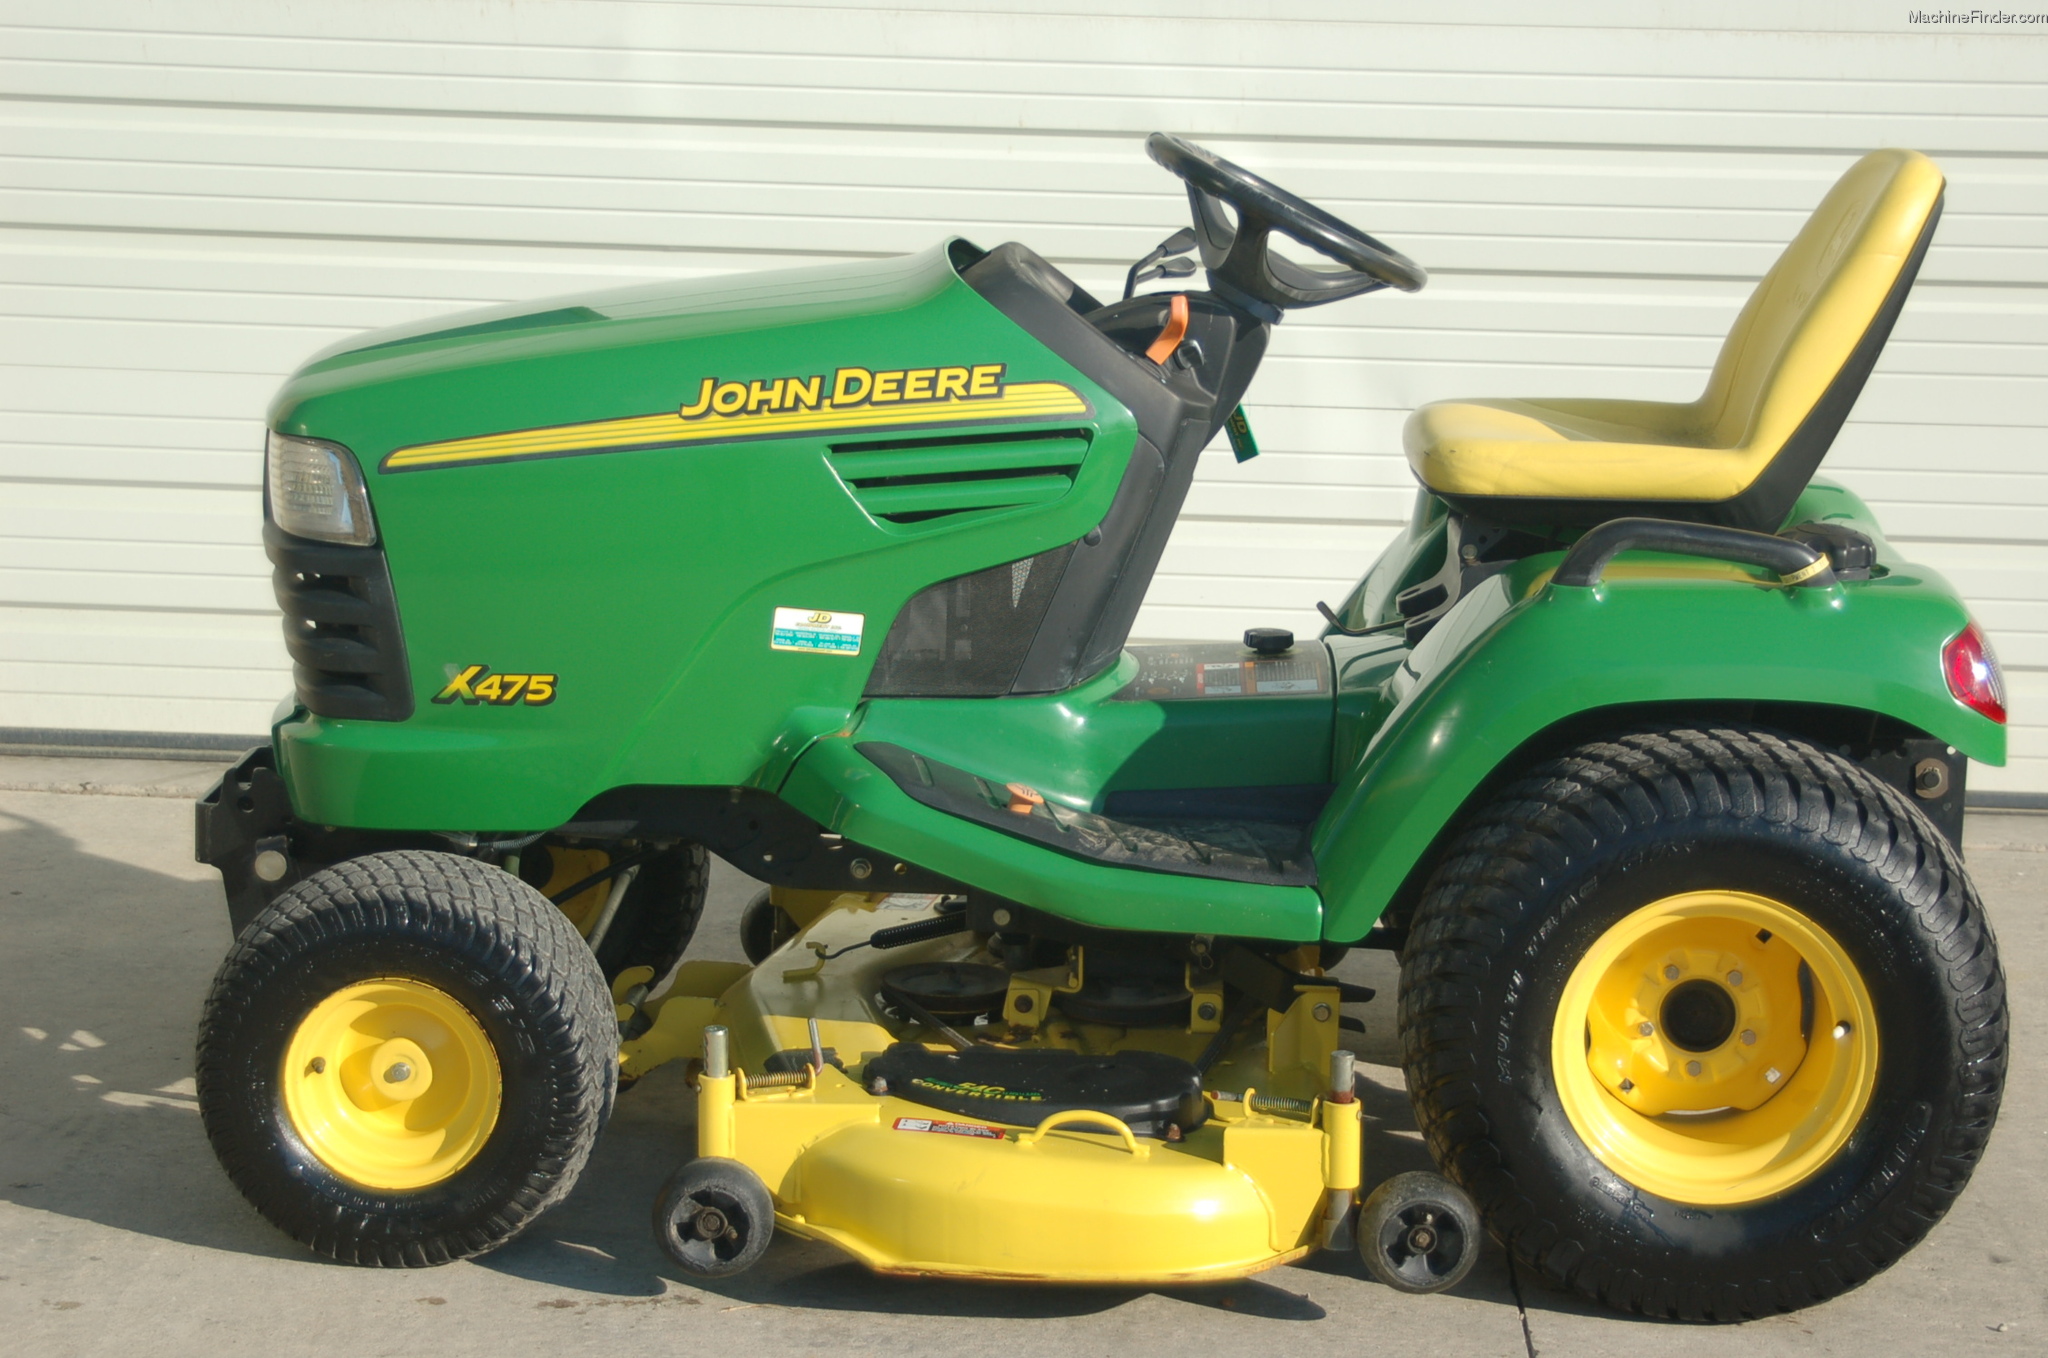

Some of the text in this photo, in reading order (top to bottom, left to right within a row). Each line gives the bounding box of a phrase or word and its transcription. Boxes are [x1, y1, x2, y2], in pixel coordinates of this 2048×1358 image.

[680, 364, 1006, 420] JOHN DEERE
[808, 613, 832, 624] JD
[431, 664, 558, 706] X475
[911, 1078, 1042, 1101] CONVERTIBLE
